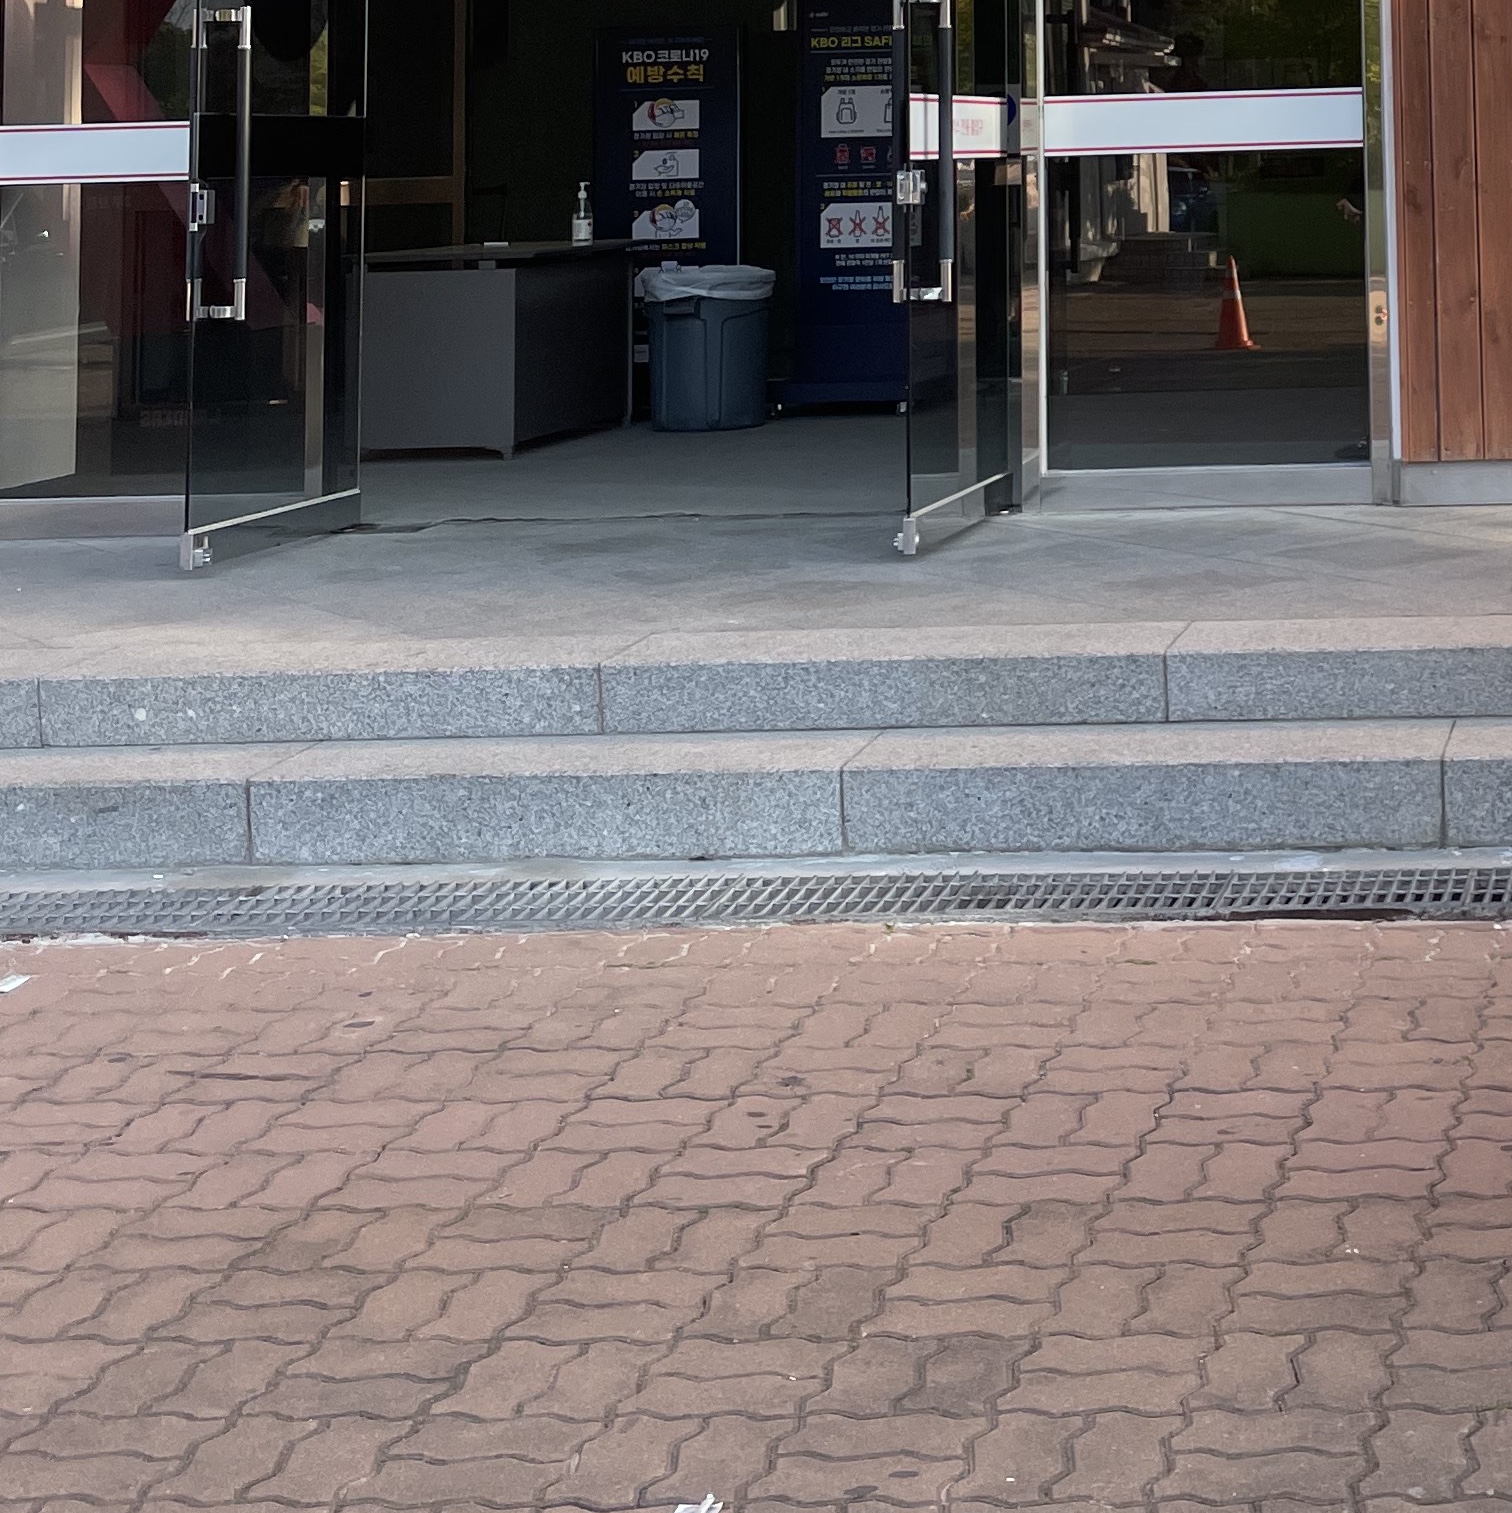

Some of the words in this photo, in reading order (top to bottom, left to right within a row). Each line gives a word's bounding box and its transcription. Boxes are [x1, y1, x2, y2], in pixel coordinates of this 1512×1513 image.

[810, 37, 838, 49] KBO
[622, 50, 656, 64] KBO
[626, 64, 705, 85] 예방수칙
